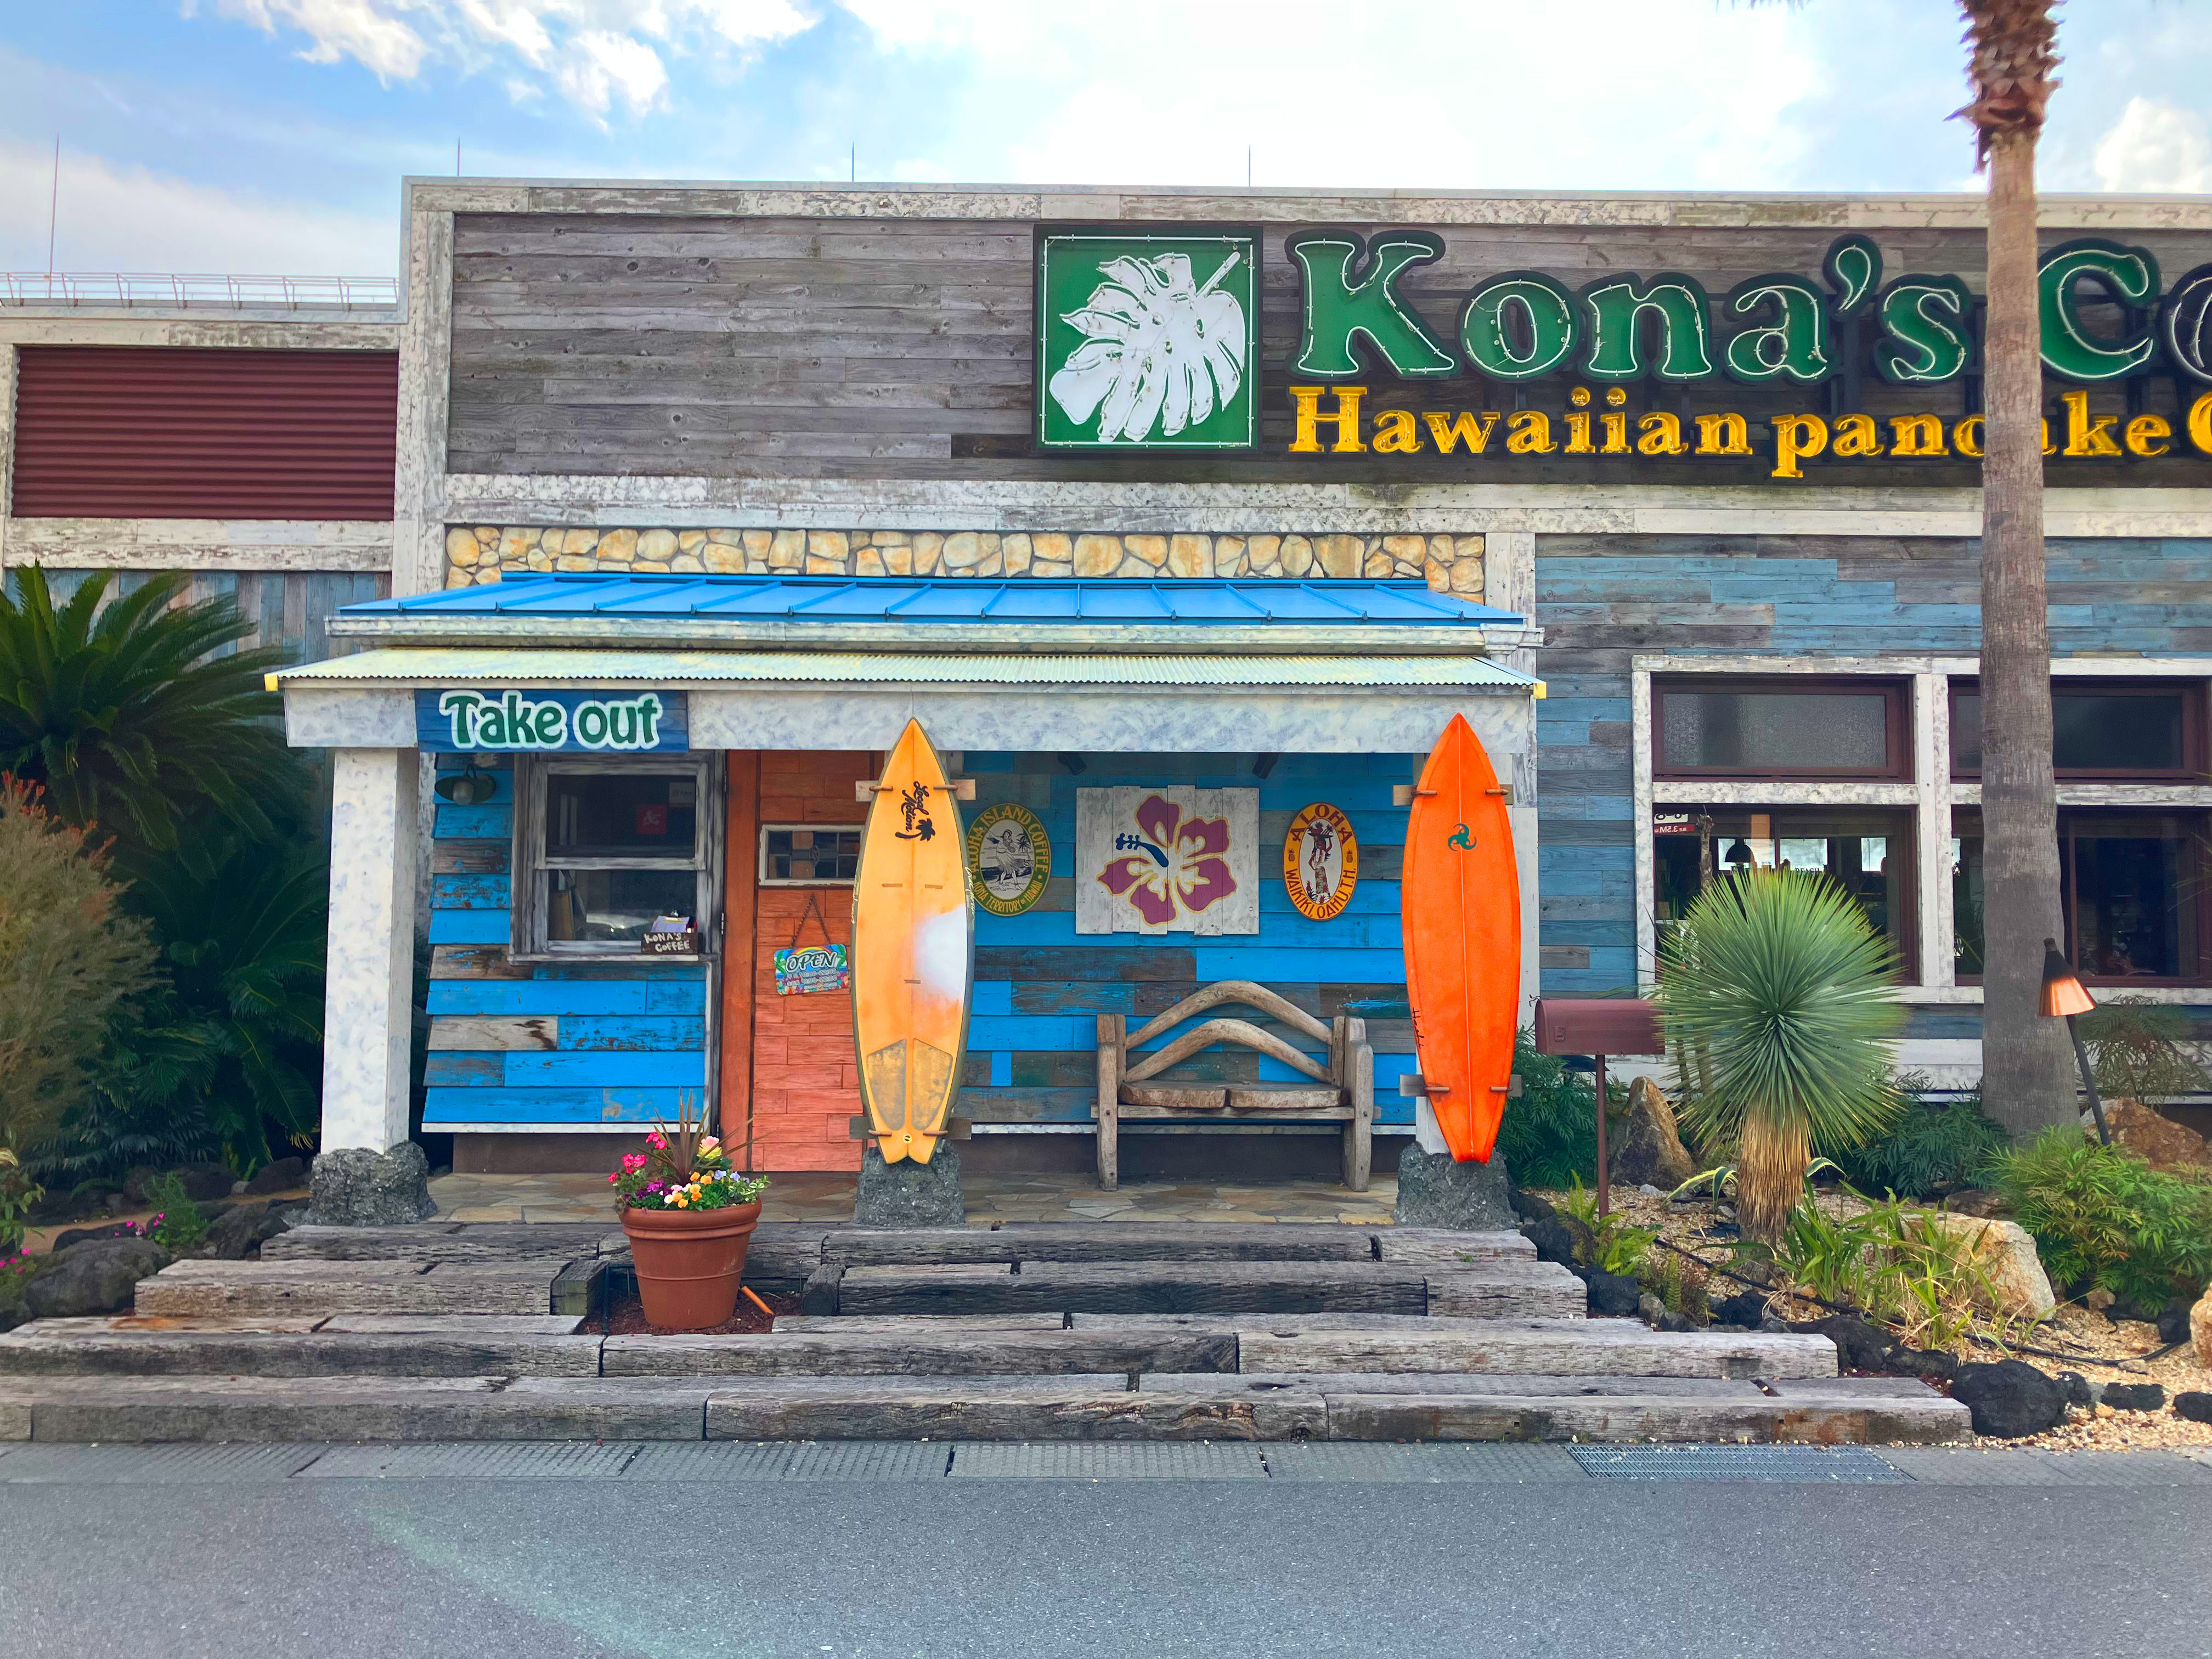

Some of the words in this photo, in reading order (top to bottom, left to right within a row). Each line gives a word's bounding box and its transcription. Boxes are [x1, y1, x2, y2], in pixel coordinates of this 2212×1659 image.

[1287, 232, 1971, 384] Kona's
[1288, 386, 1753, 456] Hawaiian
[1770, 390, 2172, 478] pancke
[441, 691, 566, 748] Take
[574, 694, 661, 748] out
[901, 789, 916, 833] Motion
[913, 781, 929, 815] Local
[967, 826, 985, 872] ALOHA
[979, 805, 1032, 827] ISLAND
[1028, 823, 1050, 873] COFFEE
[1290, 804, 1353, 845] ALOHA
[986, 895, 1023, 913] TERRITORY
[1024, 880, 1043, 903] HAWAII
[786, 951, 836, 972] OPEN
